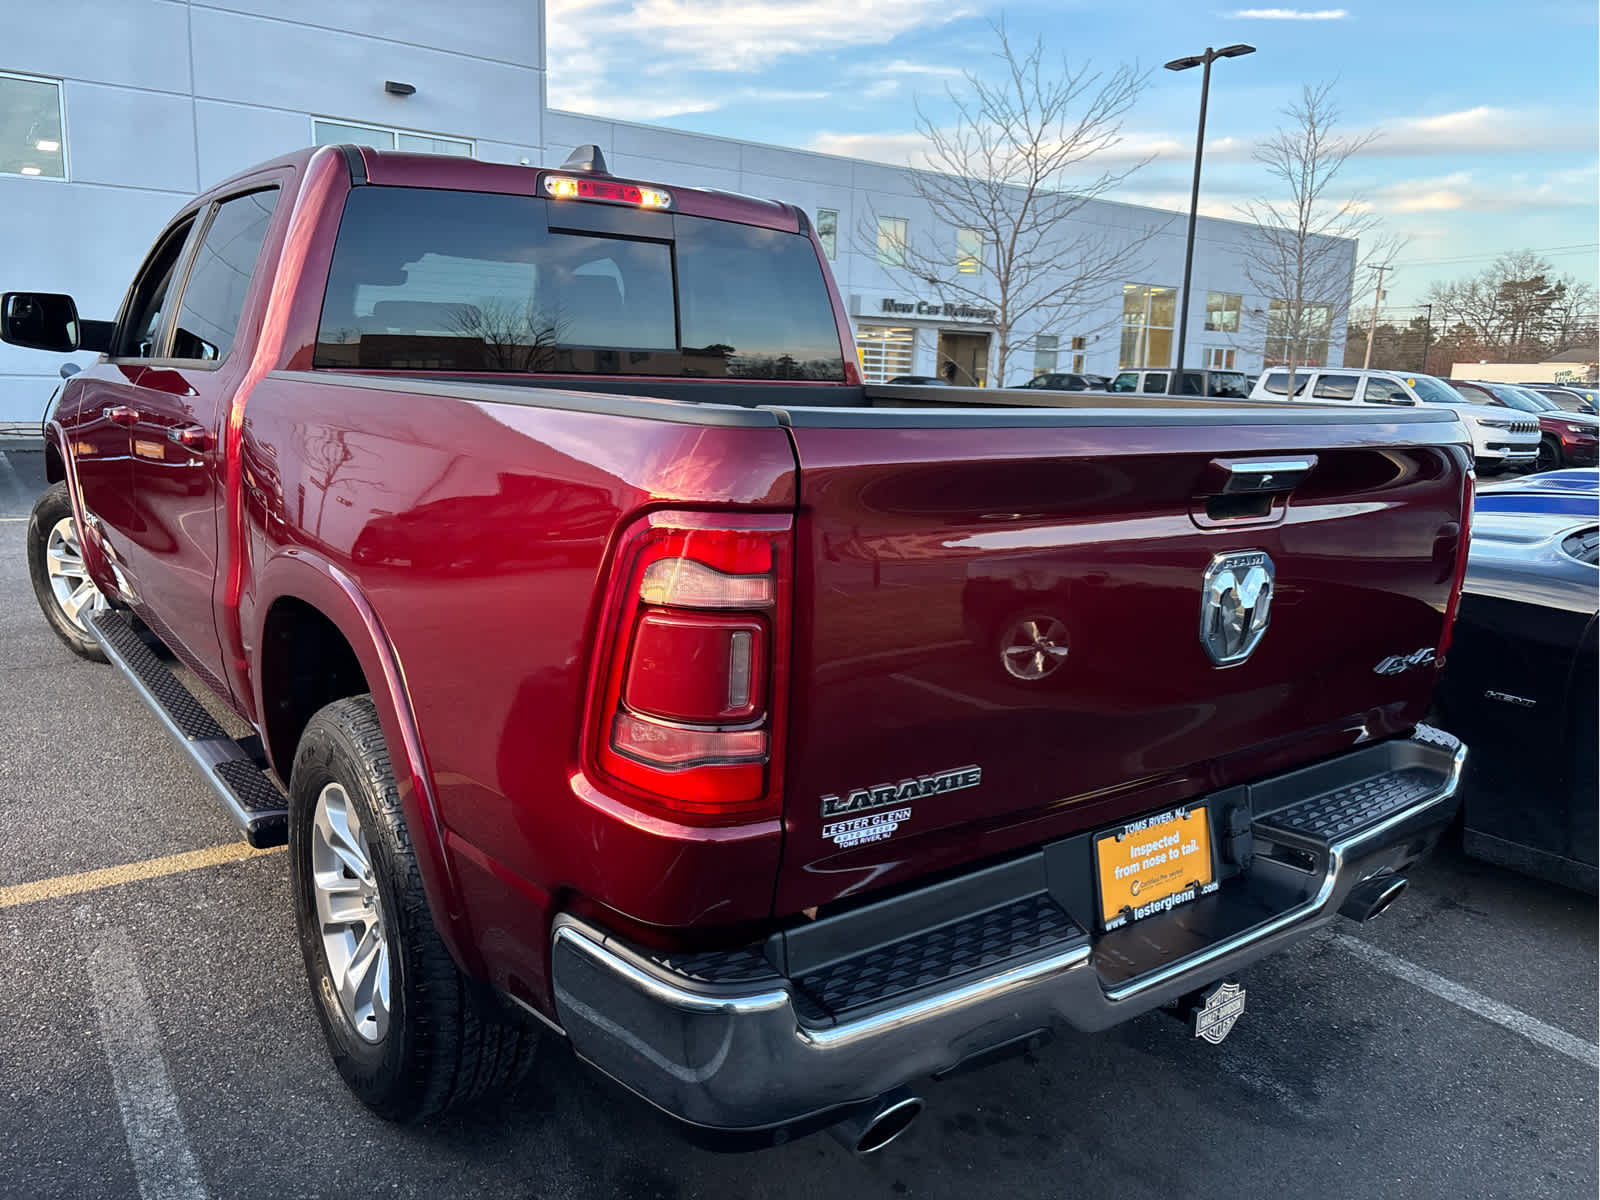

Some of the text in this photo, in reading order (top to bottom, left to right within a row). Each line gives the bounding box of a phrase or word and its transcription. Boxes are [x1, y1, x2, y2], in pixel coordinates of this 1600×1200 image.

[883, 298, 914, 313] New
[917, 301, 942, 315] Car
[820, 764, 982, 818] LARAMIE
[822, 808, 912, 836] LESTER GLENN
[1124, 819, 1147, 834] TOMS
[1175, 807, 1186, 817] NJ
[839, 831, 892, 849] TOMS RIVER, NJ
[1130, 830, 1180, 859] Inspected
[1114, 861, 1140, 880] from
[1142, 852, 1167, 870] nose
[1168, 847, 1180, 861] to
[1181, 839, 1199, 856] tail.
[1133, 890, 1196, 920] lesterglenn
[1200, 881, 1219, 895] .com
